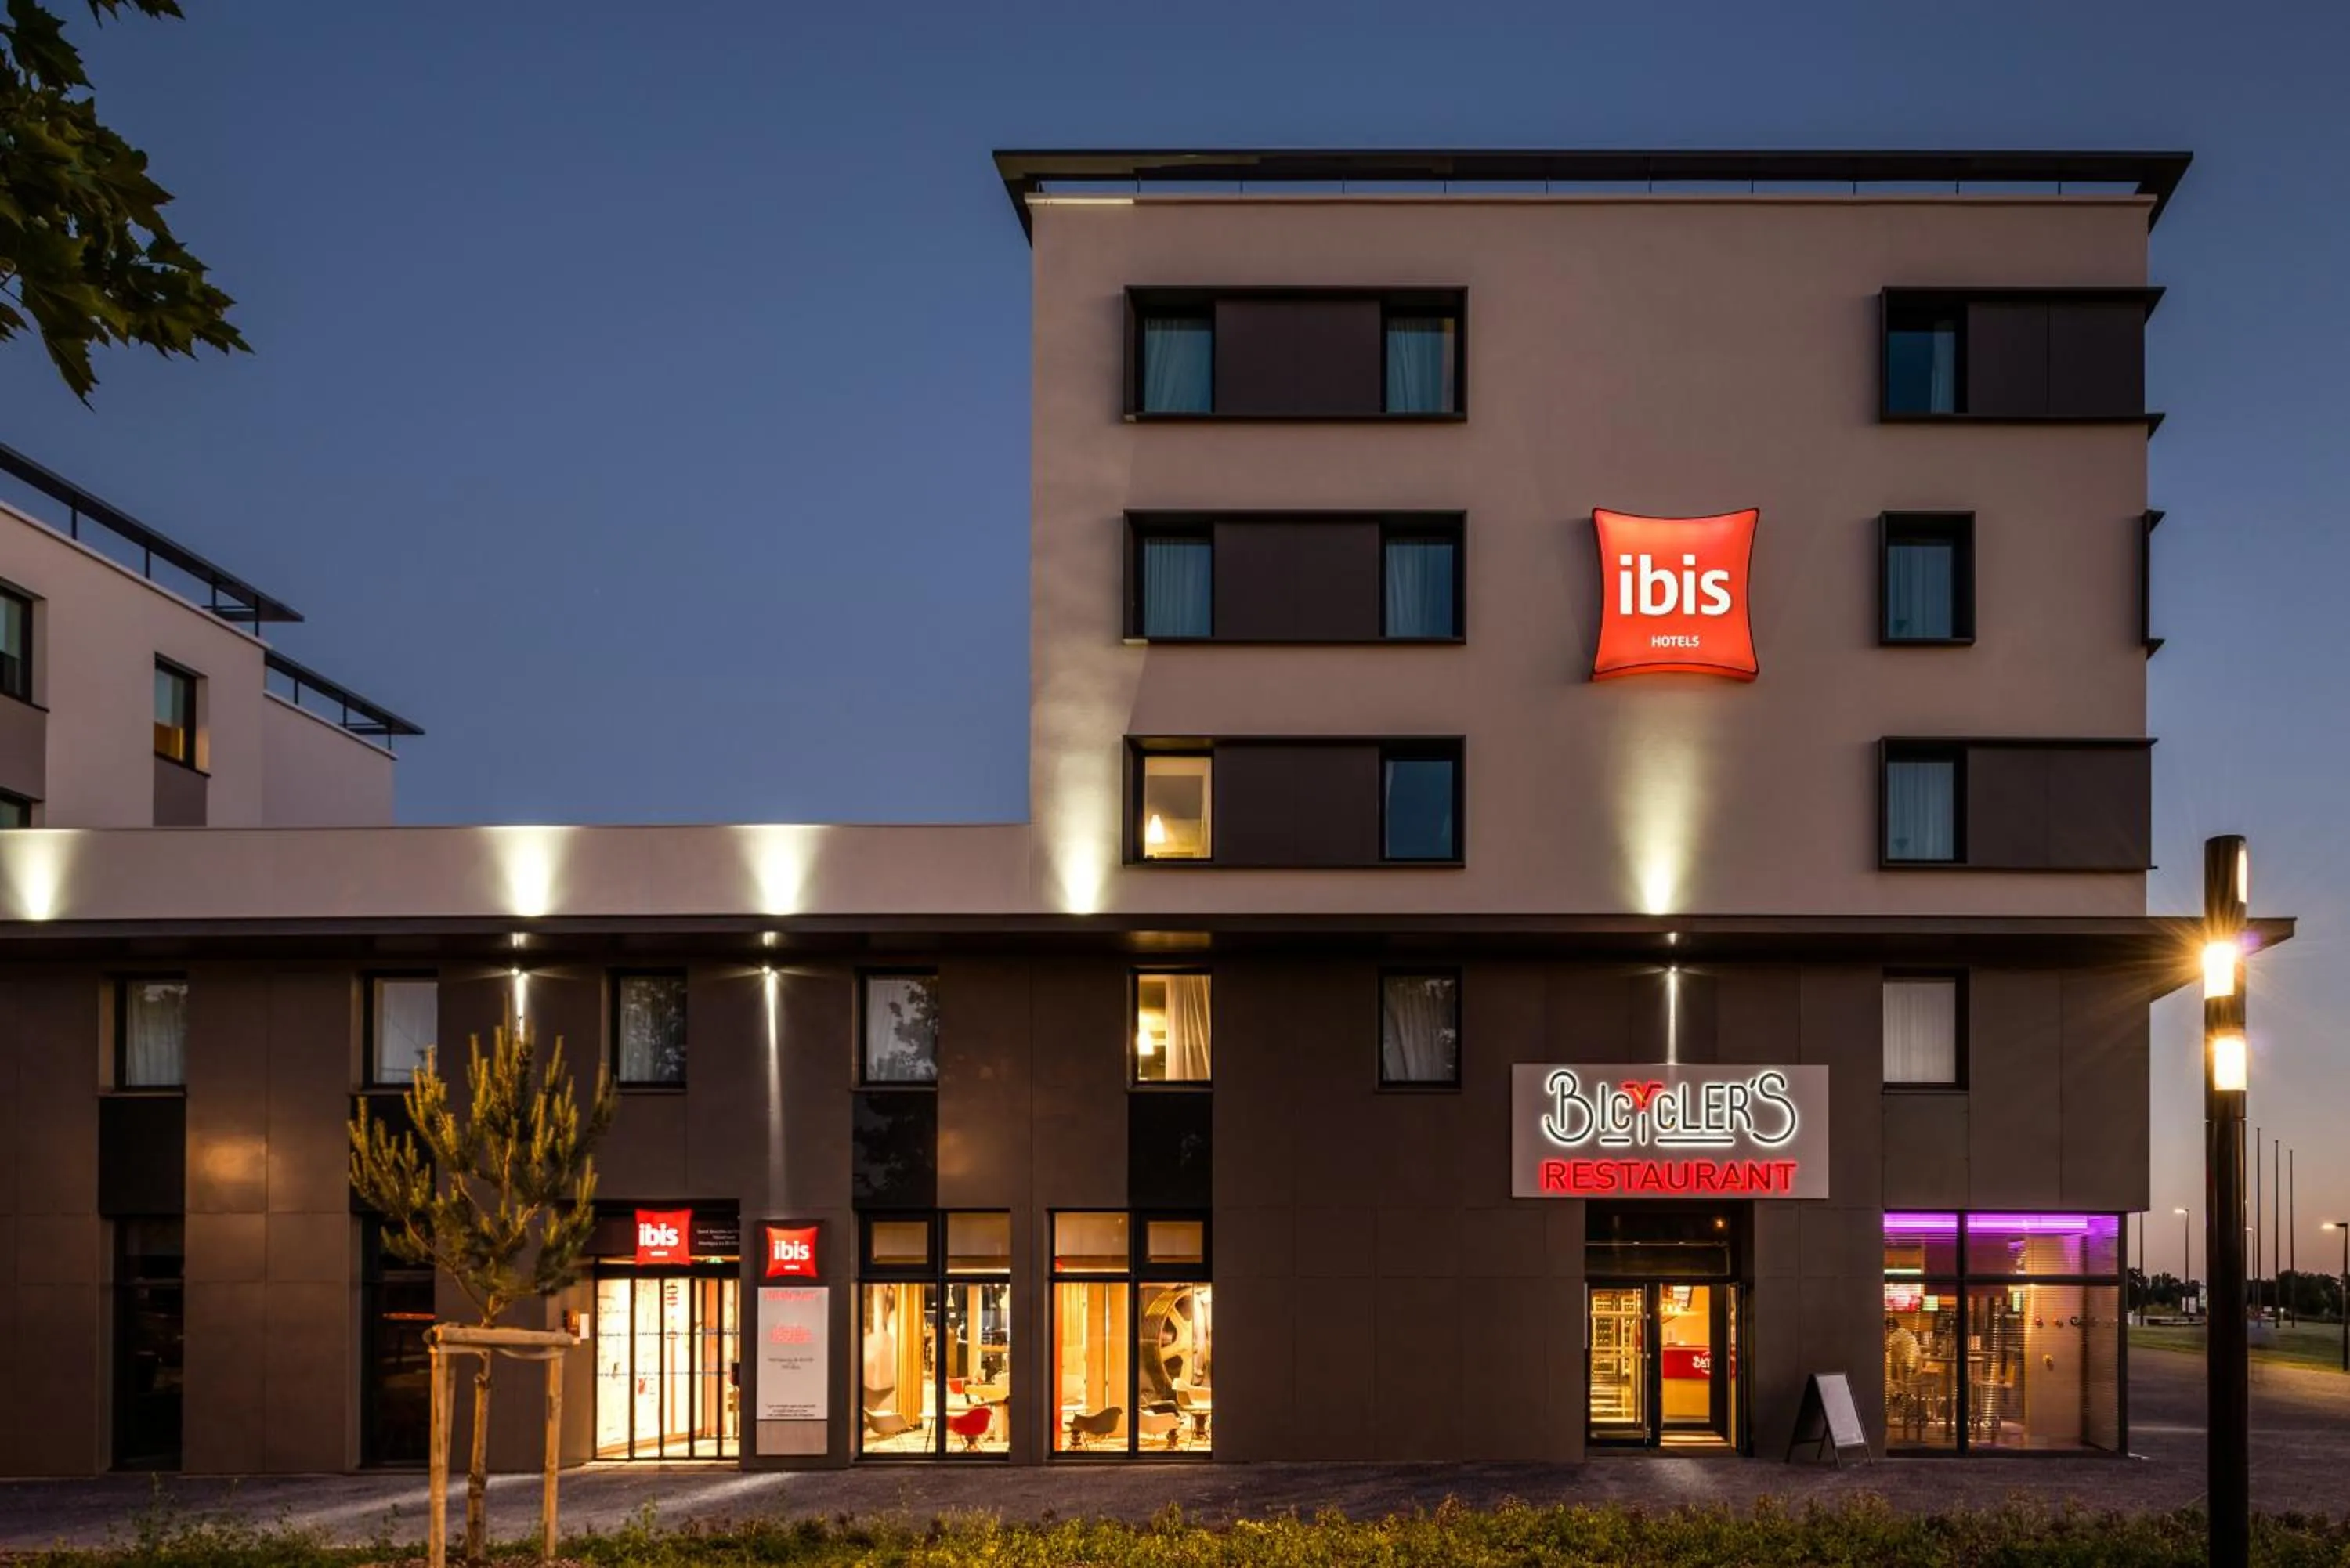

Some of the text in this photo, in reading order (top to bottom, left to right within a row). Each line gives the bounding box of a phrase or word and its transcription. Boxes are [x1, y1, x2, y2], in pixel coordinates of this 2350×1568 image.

[1619, 554, 1731, 616] ibis
[1650, 635, 1700, 648] HOTELS
[1544, 1070, 1797, 1144] BICYCLER'S
[1543, 1161, 1798, 1191] RESTAURANT
[638, 1223, 679, 1247] ibis
[773, 1240, 811, 1260] ibis
